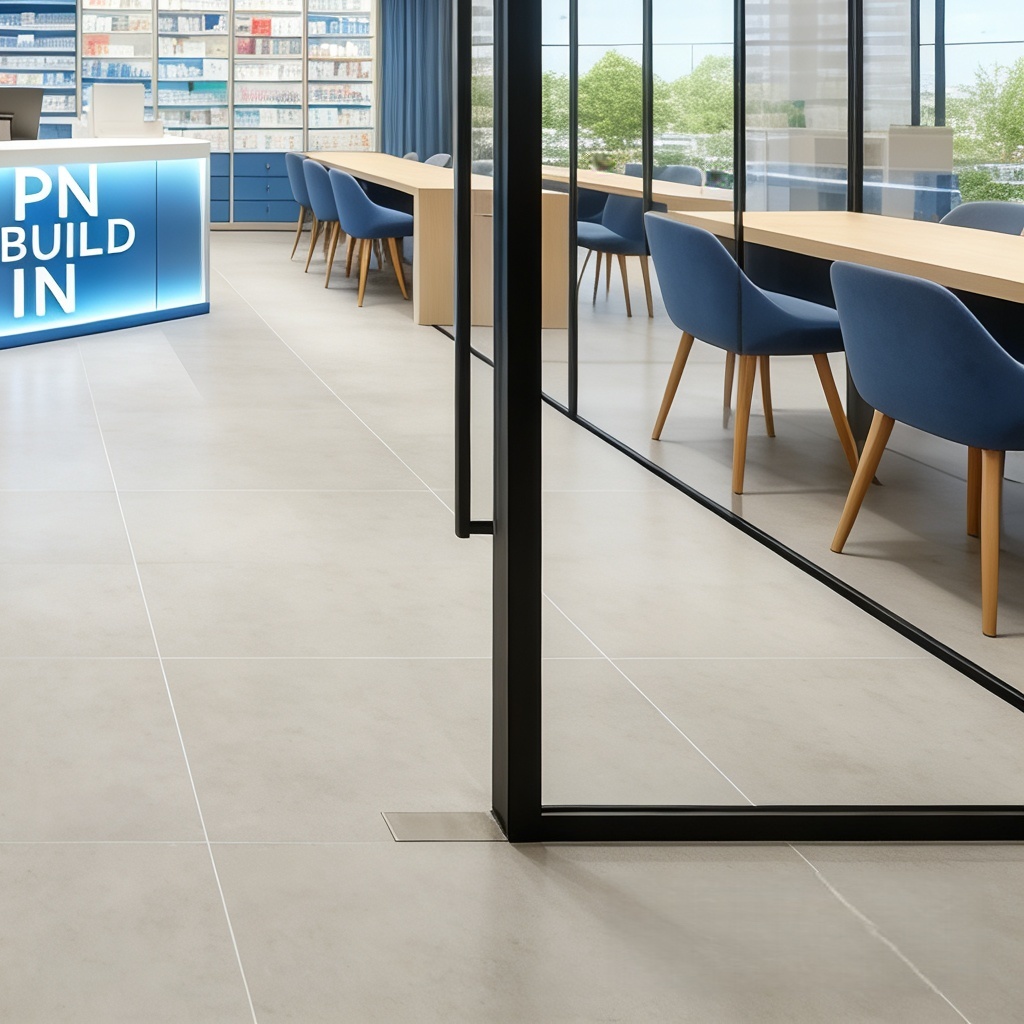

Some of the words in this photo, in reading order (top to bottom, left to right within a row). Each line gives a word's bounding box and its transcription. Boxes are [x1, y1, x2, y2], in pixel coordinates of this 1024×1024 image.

[14, 163, 99, 221] PN
[1, 218, 136, 263] BUILD
[13, 263, 76, 319] IN
